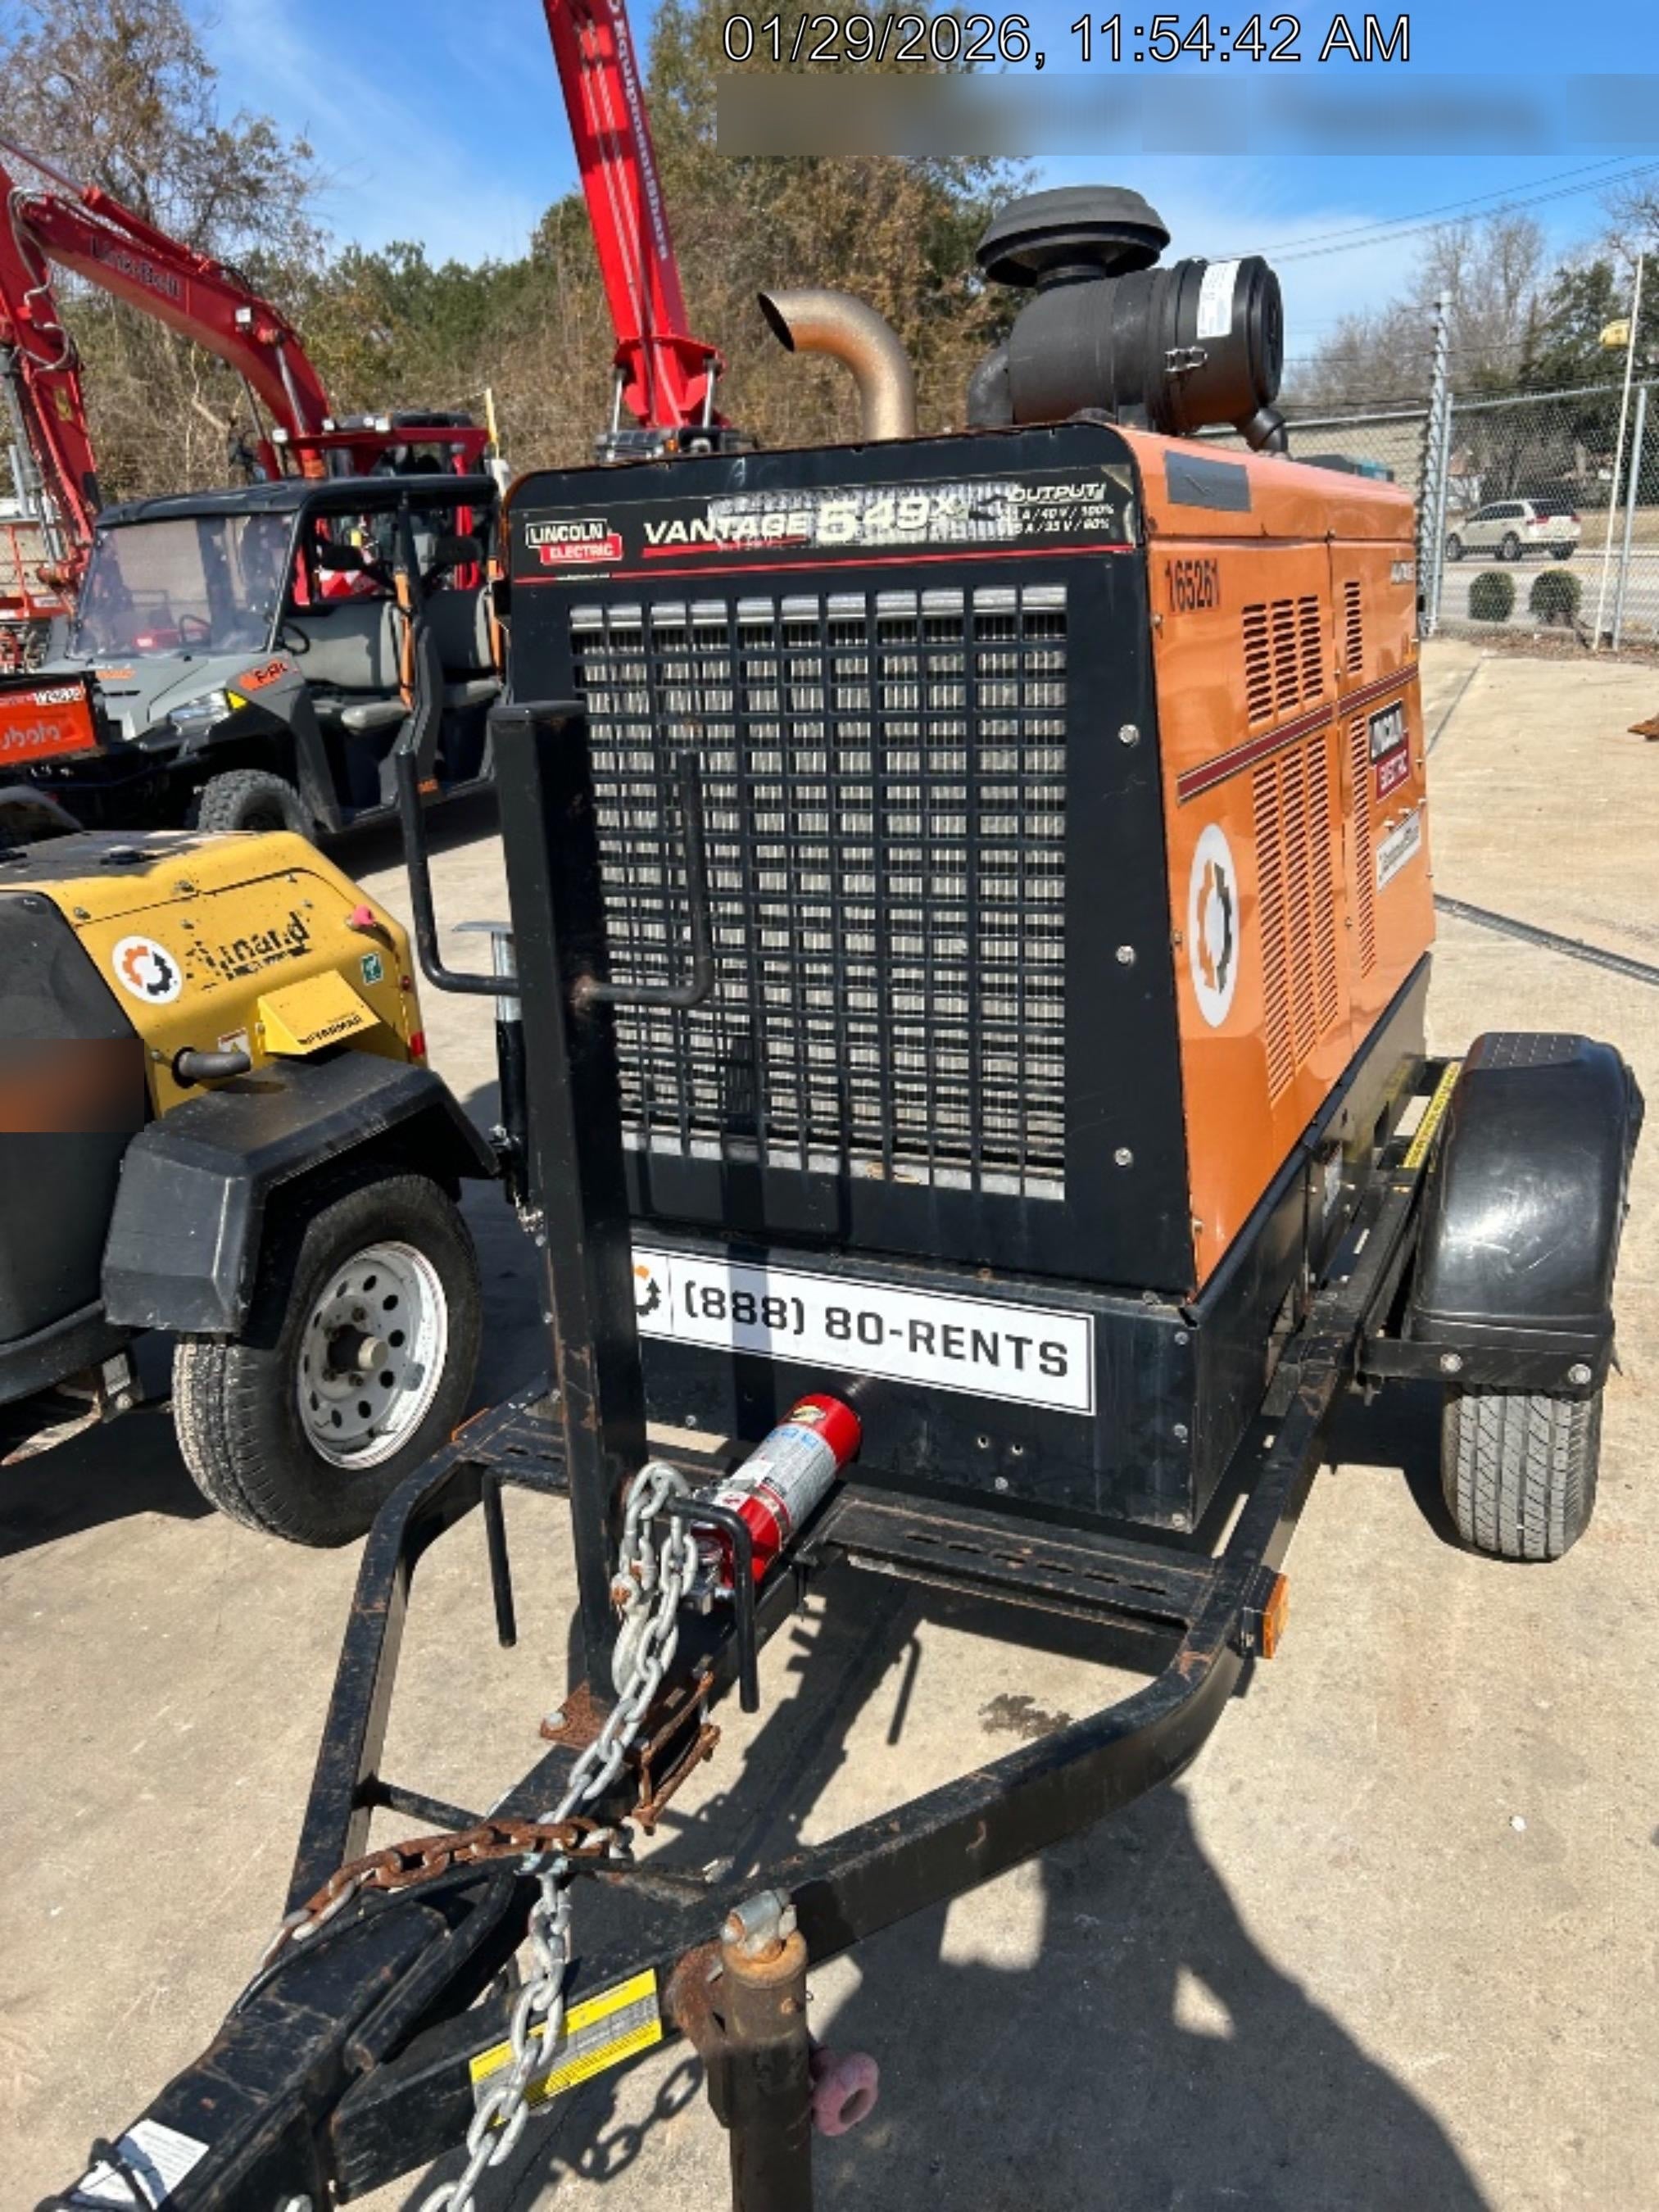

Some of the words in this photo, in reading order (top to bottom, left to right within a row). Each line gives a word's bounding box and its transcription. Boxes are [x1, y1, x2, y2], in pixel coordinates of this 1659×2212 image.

[1007, 482, 1101, 503] OUTPUT
[529, 522, 604, 545] LINCOLN
[642, 511, 810, 545] VANTAGE
[549, 542, 614, 560] ELECTRIC
[1164, 558, 1220, 612] 165261
[683, 1280, 805, 1336] (888)
[825, 1306, 1070, 1378] 80-RENTS
